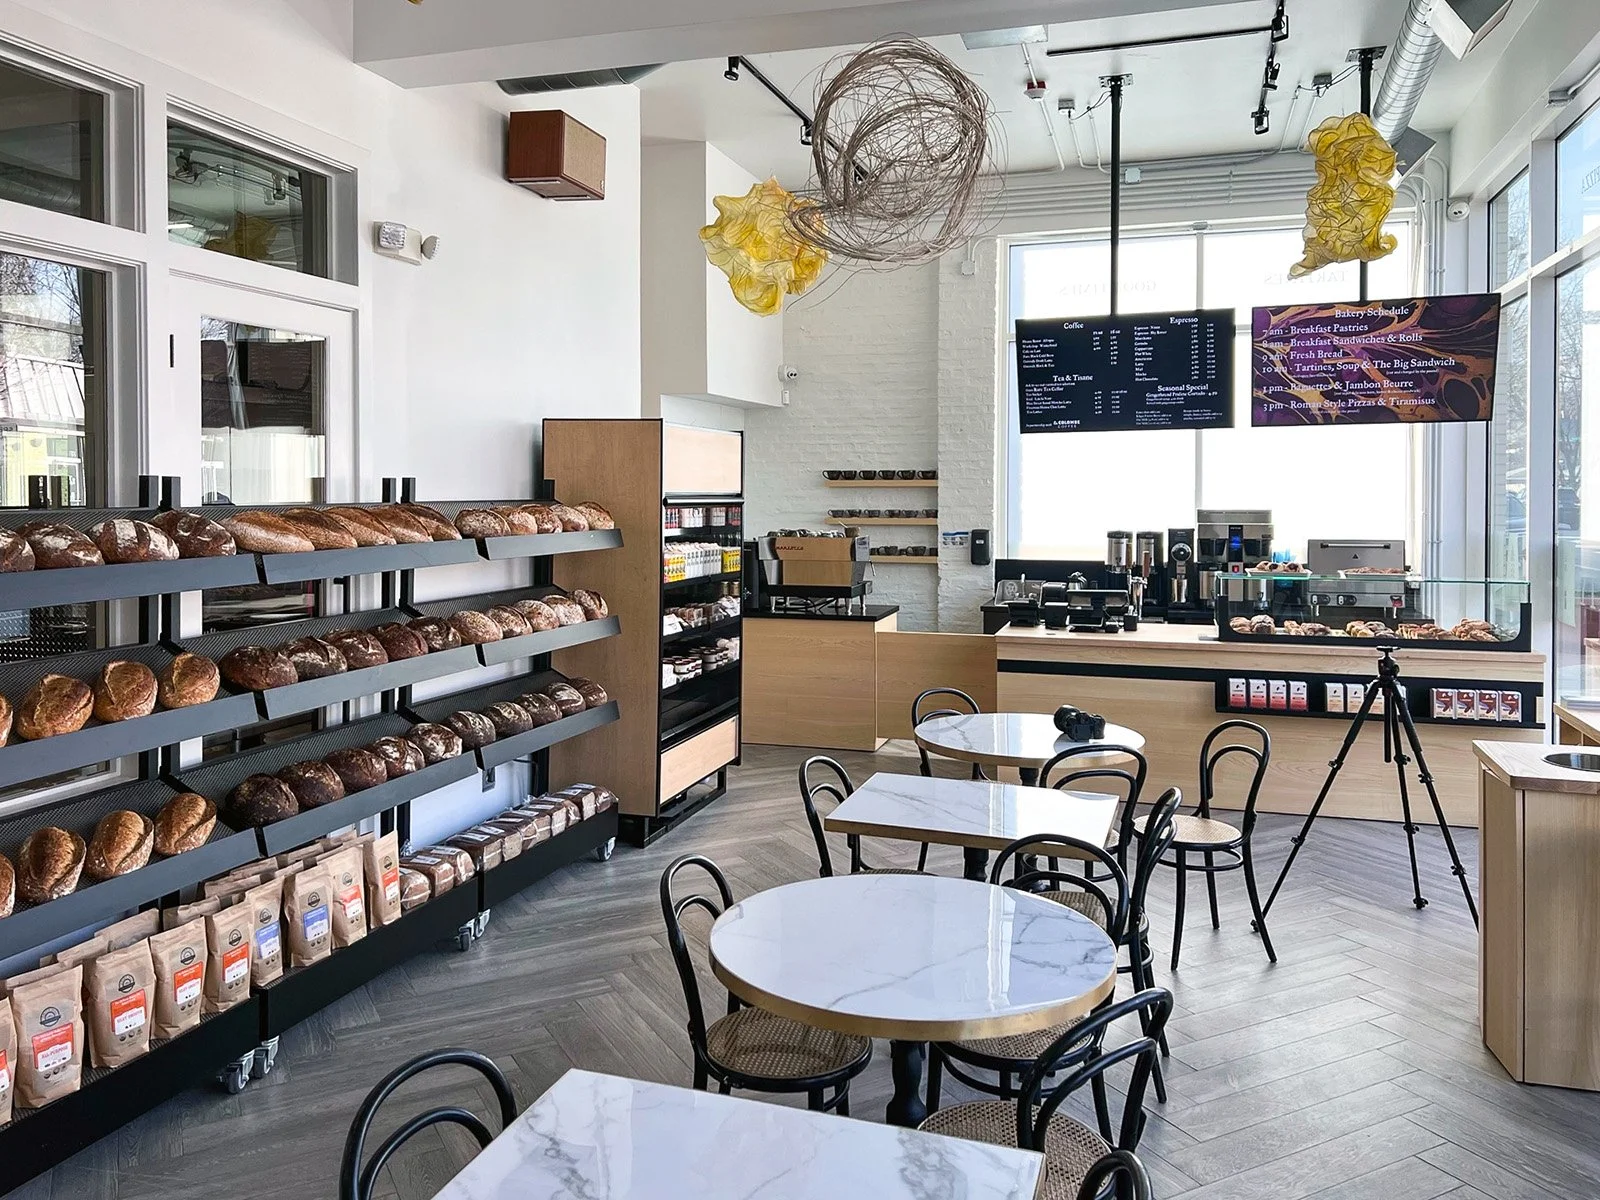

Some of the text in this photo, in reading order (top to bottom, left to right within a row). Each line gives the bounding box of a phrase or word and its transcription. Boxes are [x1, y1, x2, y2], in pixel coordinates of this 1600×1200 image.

[1335, 306, 1409, 319] Bakery Schedule
[1169, 316, 1199, 325] Espresso
[1290, 325, 1332, 334] Breakfast
[1333, 322, 1368, 332] Pastries
[1262, 340, 1268, 348] 8
[1290, 337, 1332, 347] Breakfast
[1333, 335, 1385, 345] Sandwiches
[1387, 334, 1397, 342] &
[1399, 333, 1423, 342] Rolls
[1290, 350, 1315, 359] Fresh
[1317, 349, 1343, 359] Bread
[1294, 362, 1335, 372] Tartines,
[1336, 361, 1359, 372] Soup
[1361, 360, 1371, 369] &
[1373, 359, 1391, 369] The
[1394, 359, 1409, 370] Big
[1410, 357, 1455, 368] Sandwich
[1157, 384, 1209, 392] Seasonal Special
[1269, 386, 1284, 394] pm
[1333, 381, 1343, 389] &
[1345, 380, 1380, 392] Jambon
[1383, 379, 1413, 388] Beurre
[1269, 404, 1283, 412] pm
[1290, 400, 1321, 409] Roman
[1323, 399, 1346, 410] Style
[1347, 398, 1376, 407] Pizzas
[1377, 398, 1386, 406] &
[1389, 396, 1436, 406] Tiramisus
